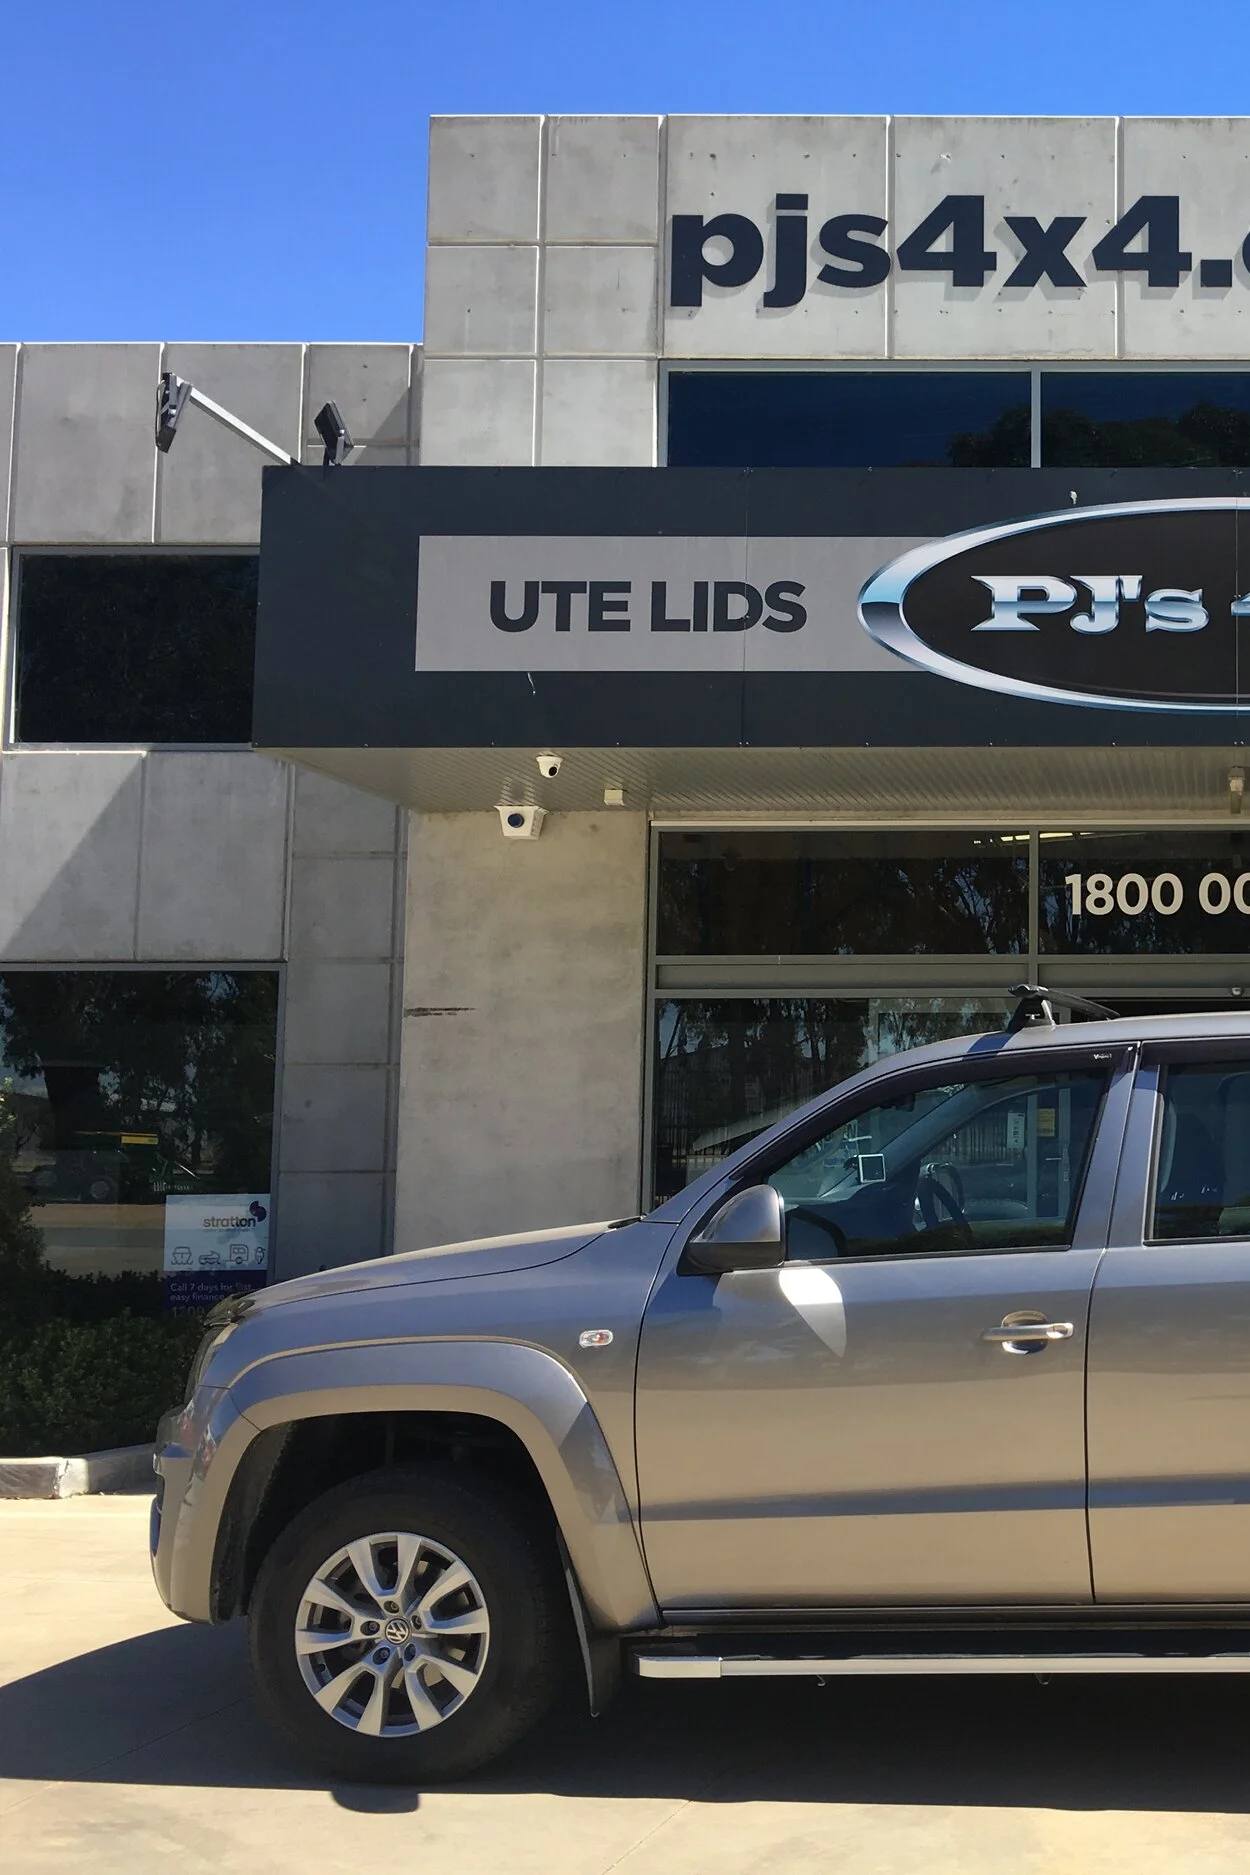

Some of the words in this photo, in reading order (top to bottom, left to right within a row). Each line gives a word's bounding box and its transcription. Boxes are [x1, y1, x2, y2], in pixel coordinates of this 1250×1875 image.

[490, 581, 631, 633] UTE
[651, 581, 807, 633] LIDS
[970, 574, 1210, 634] PJ's
[1065, 873, 1183, 915] 1800
[170, 1283, 187, 1292] Call
[189, 1283, 195, 1291] 7
[198, 1283, 218, 1294] days
[220, 1282, 232, 1291] for
[170, 1294, 190, 1303] easy
[192, 1292, 225, 1301] finance
